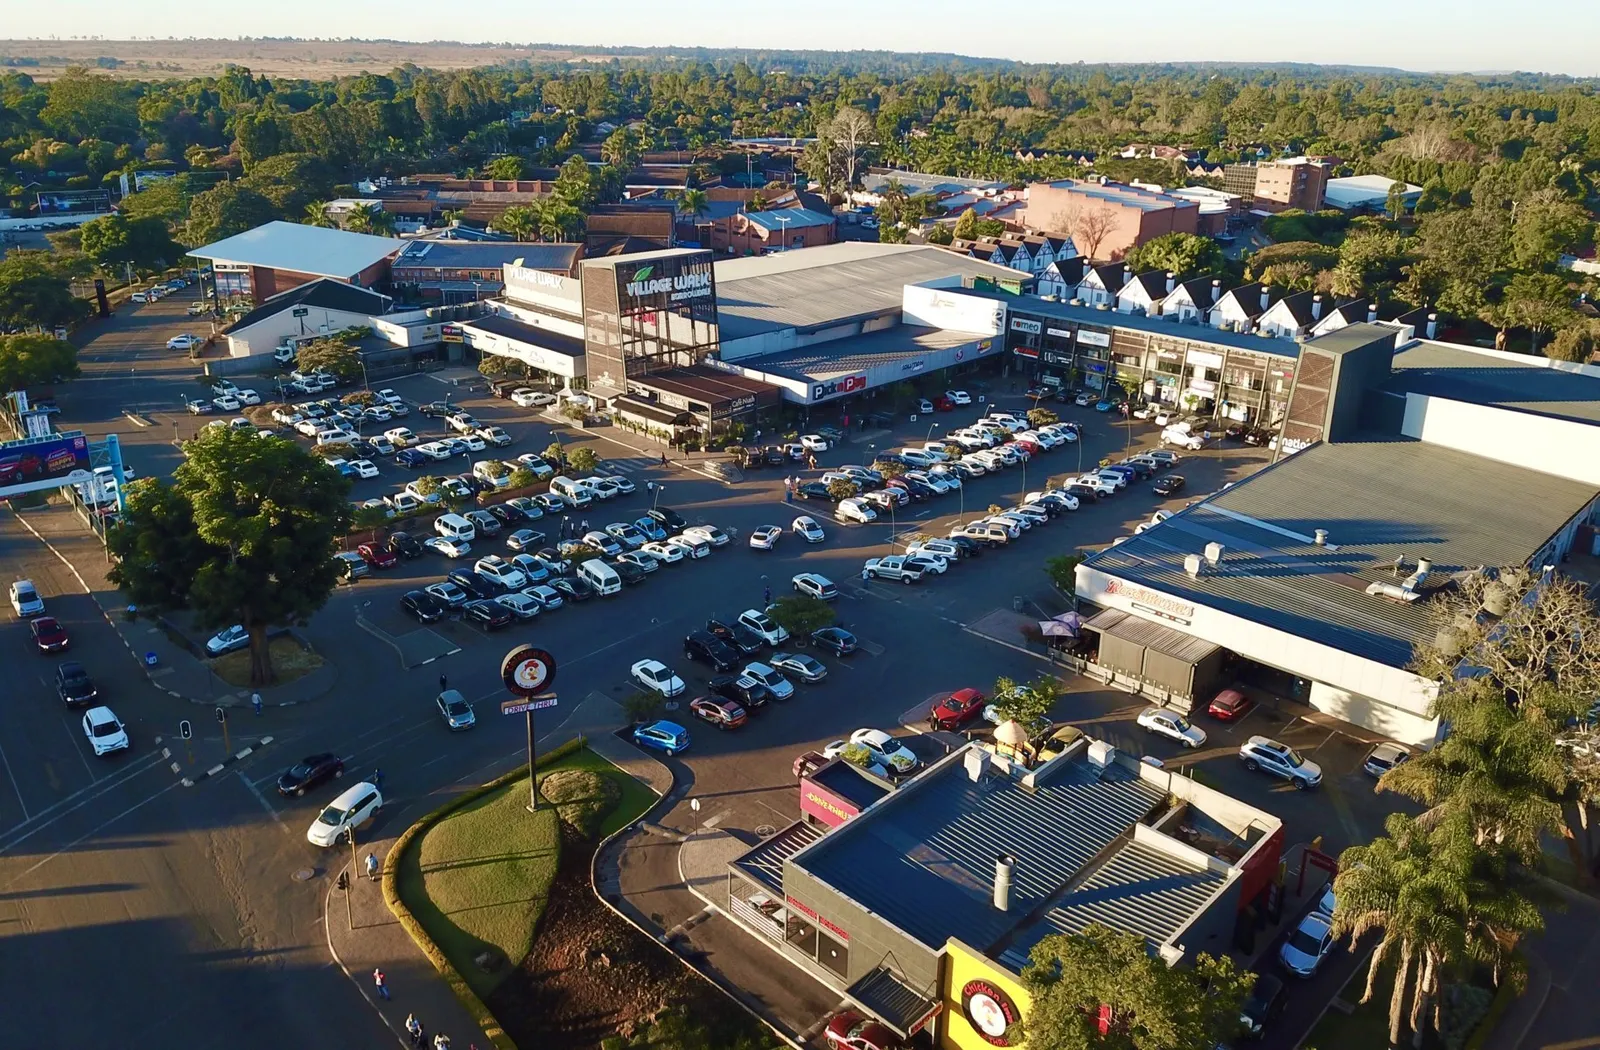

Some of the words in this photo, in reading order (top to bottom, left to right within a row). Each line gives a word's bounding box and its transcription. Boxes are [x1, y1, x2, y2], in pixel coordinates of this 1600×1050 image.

[626, 277, 672, 296] VILLAGE
[674, 272, 710, 290] WALK
[1013, 321, 1039, 332] romeo
[844, 374, 866, 393] Pay
[964, 982, 1000, 1001] Chicken
